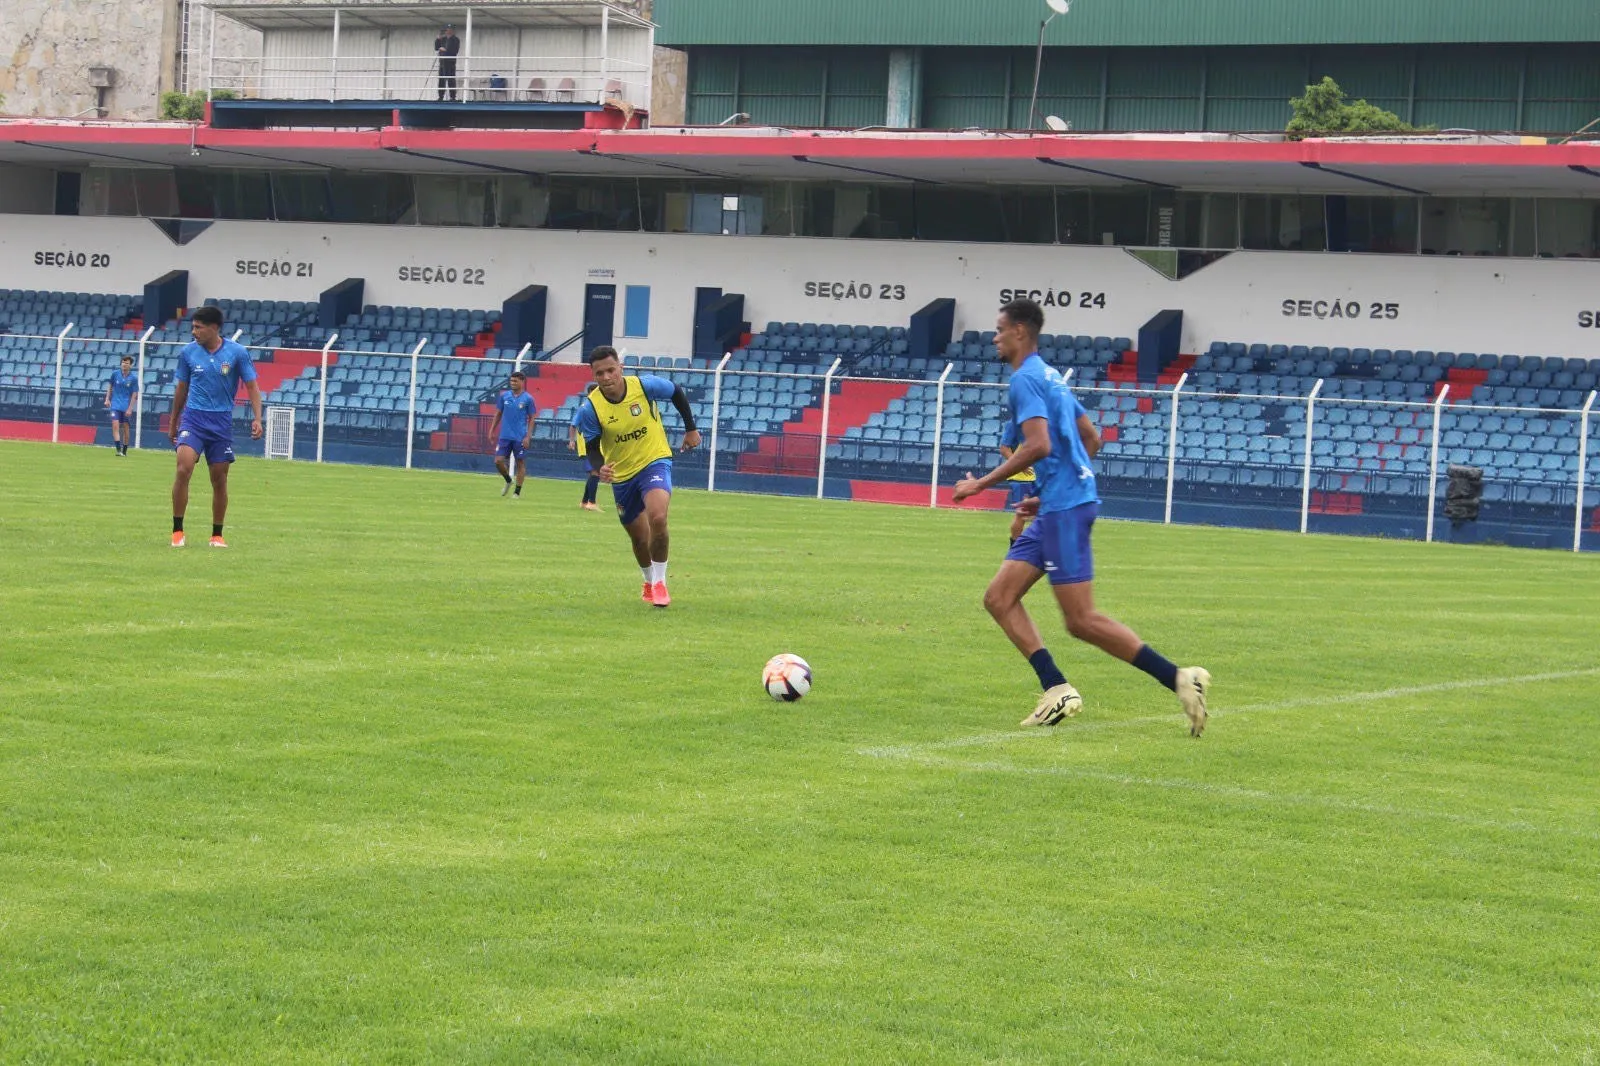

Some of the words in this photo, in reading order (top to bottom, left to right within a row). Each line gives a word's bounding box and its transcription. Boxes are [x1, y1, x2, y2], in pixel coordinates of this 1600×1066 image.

[35, 250, 87, 269] SEÇÃO
[91, 253, 110, 268] 20
[236, 259, 292, 278] SEÇÃO
[296, 262, 313, 278] 21
[399, 266, 457, 285] SEÇÃO
[462, 268, 485, 286] 22
[804, 281, 872, 301] SEÇÃO
[879, 284, 905, 301] 23
[1080, 291, 1106, 309] 24
[1281, 299, 1361, 320] SEÇÃO
[1369, 302, 1400, 320] 25
